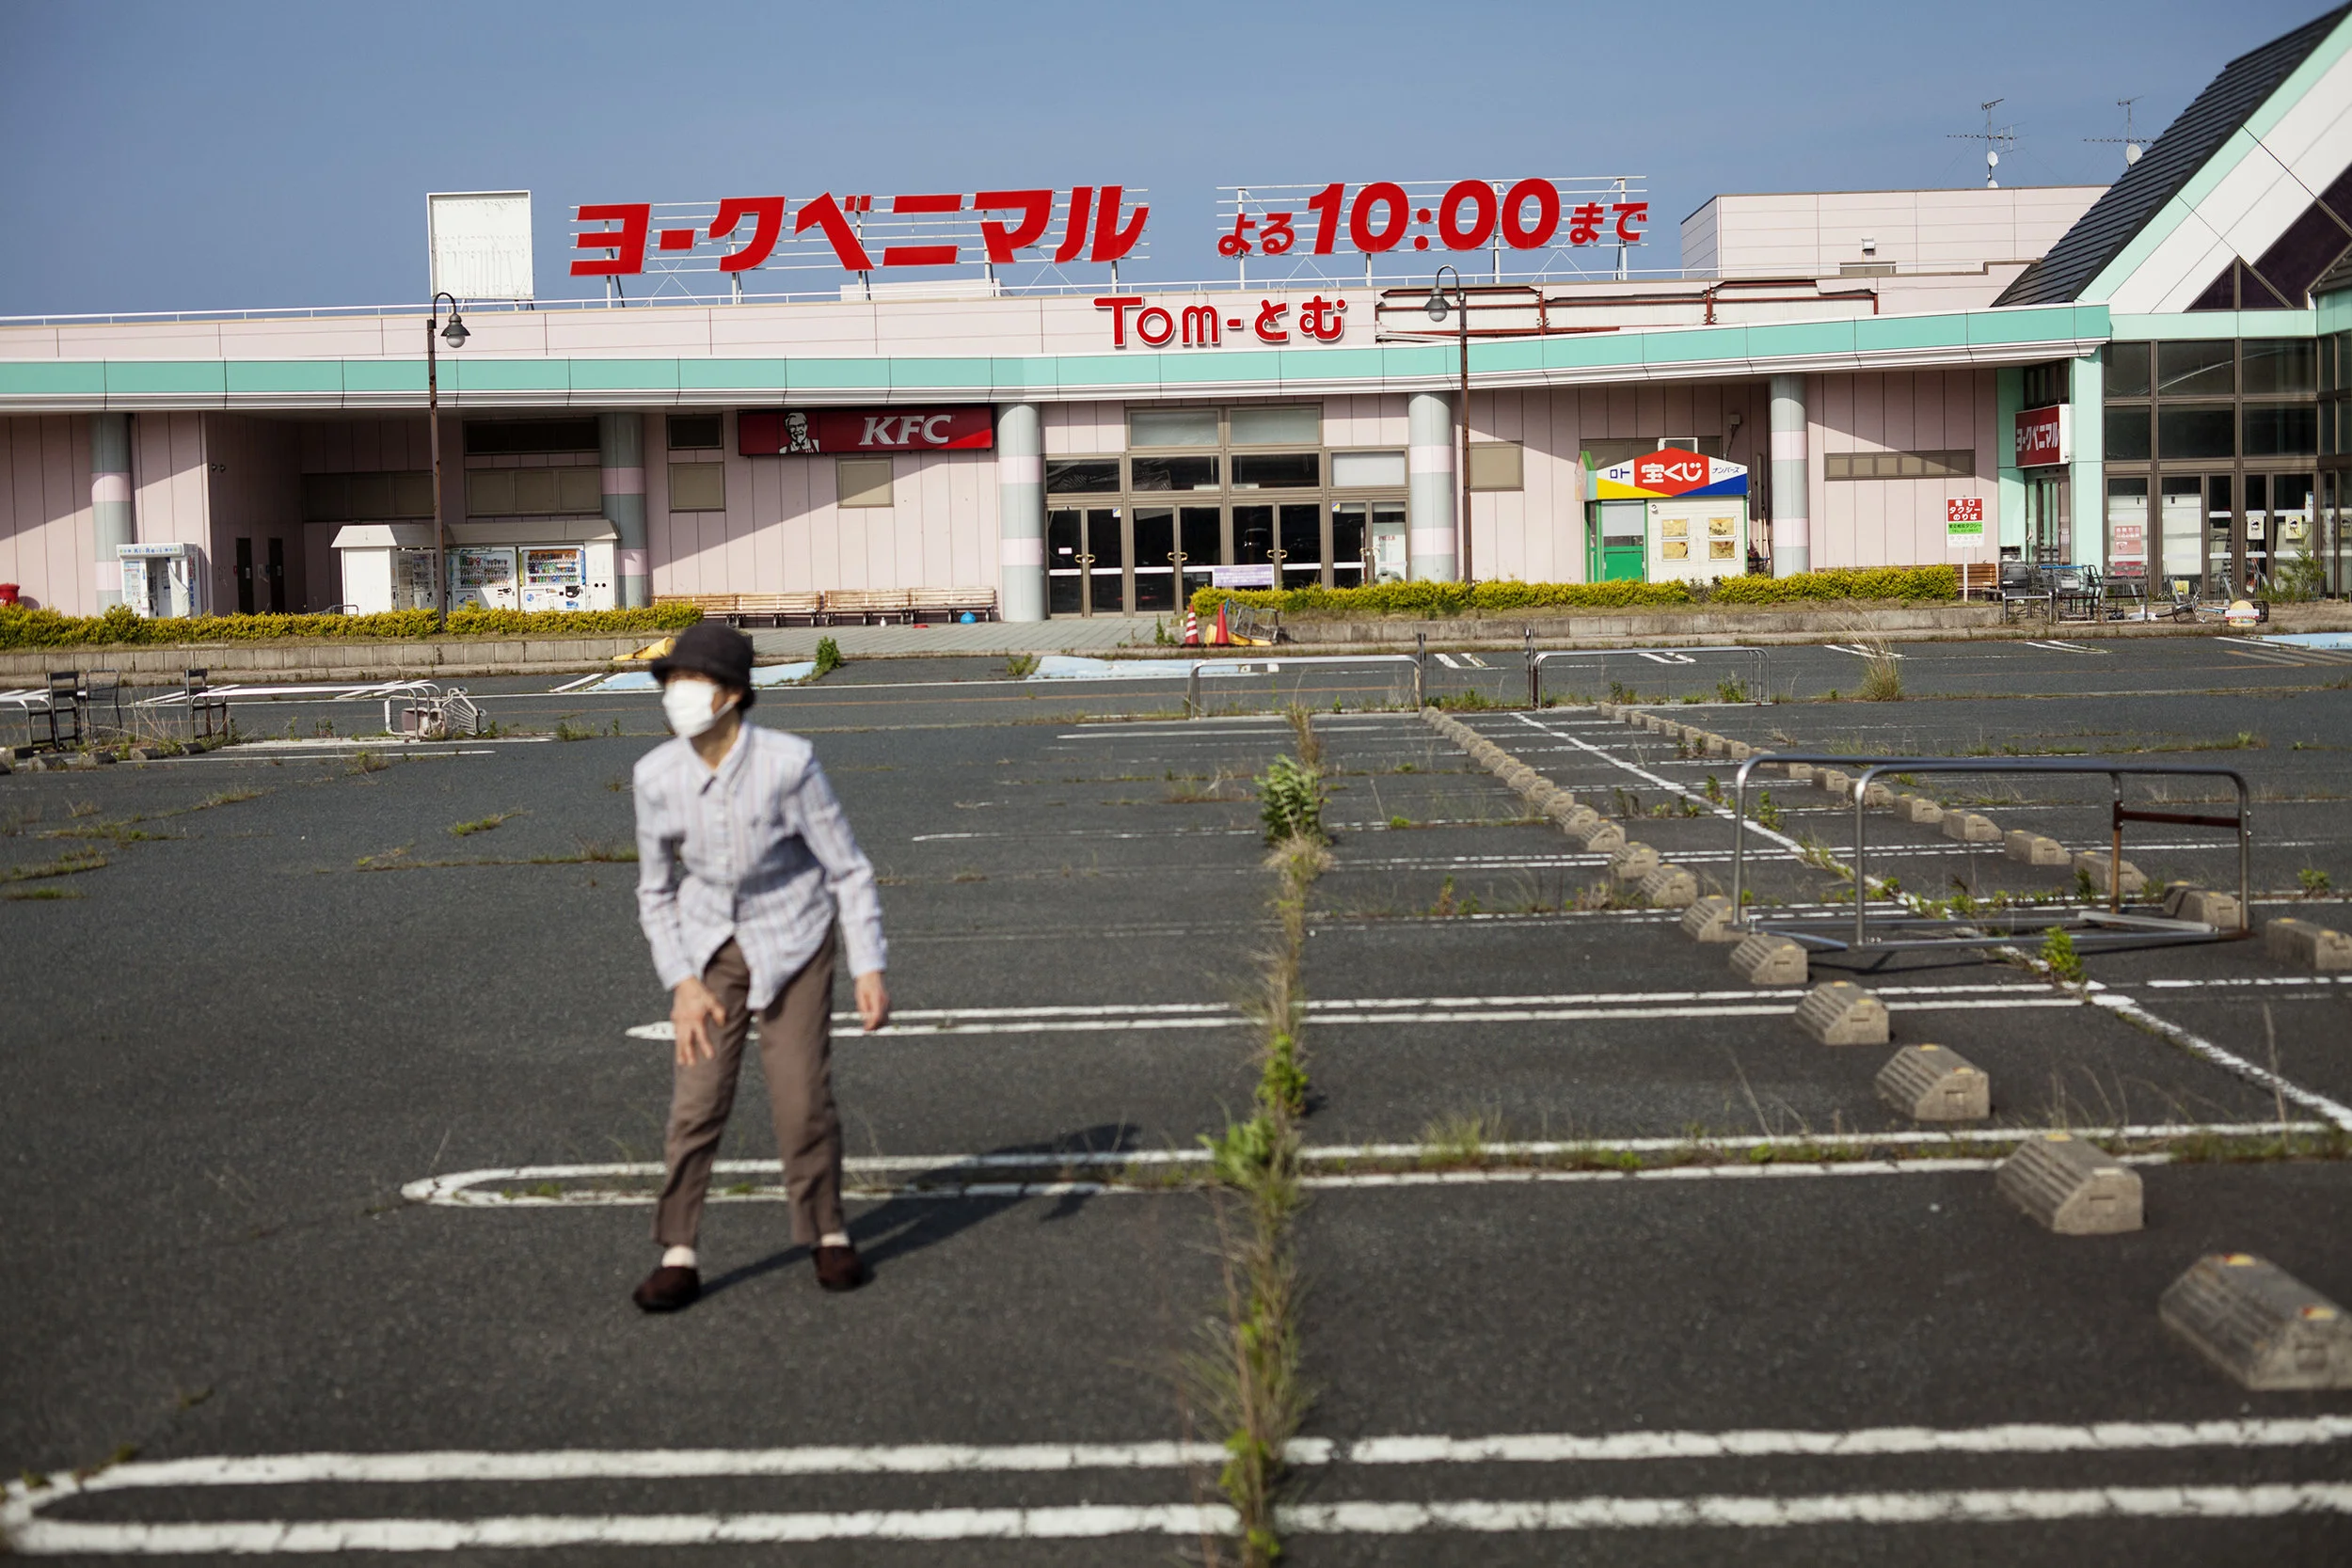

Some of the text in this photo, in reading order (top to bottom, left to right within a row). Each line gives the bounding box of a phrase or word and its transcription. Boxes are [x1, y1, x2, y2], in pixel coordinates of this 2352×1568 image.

[569, 185, 1150, 277] ヨークベニマル
[858, 414, 952, 447] KFC
[2016, 420, 2060, 452] ヨークベニマル
[1610, 462, 1740, 483] ロト 宝くじ ナンバーズ
[1948, 506, 1981, 515] タクシー
